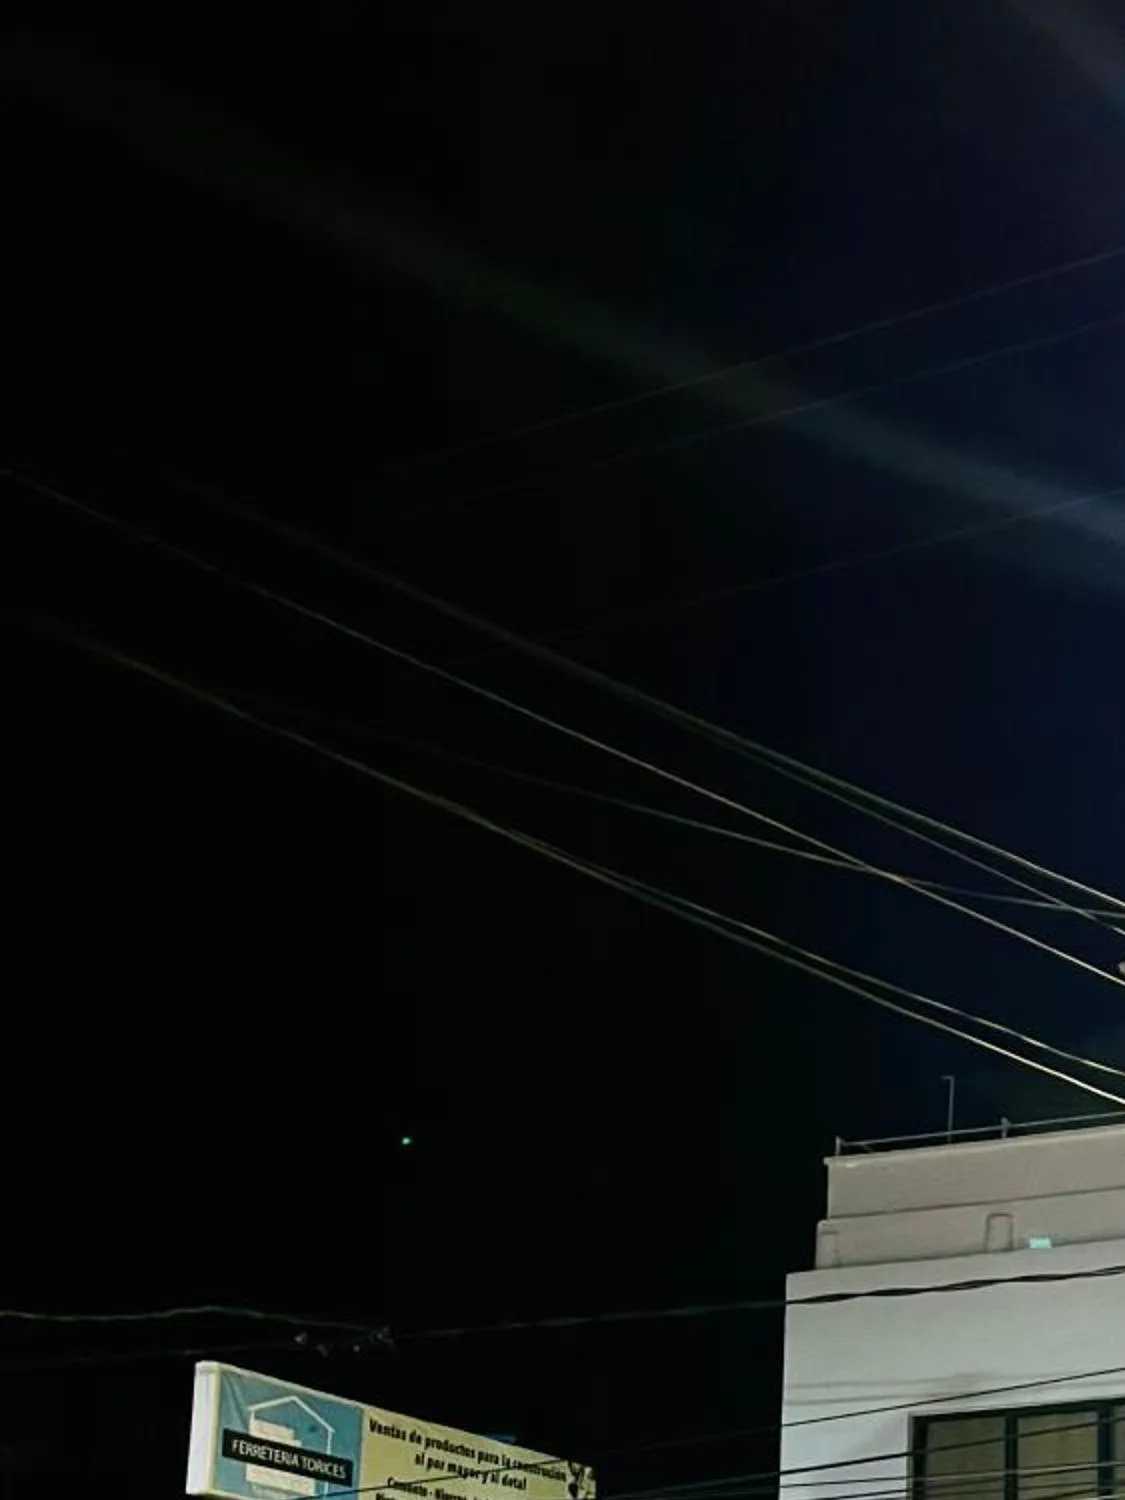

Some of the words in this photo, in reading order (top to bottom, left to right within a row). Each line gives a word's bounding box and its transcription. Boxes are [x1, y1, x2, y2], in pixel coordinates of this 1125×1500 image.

[368, 1417, 407, 1441] Ventas
[409, 1429, 422, 1445] de
[424, 1437, 475, 1460] productos
[477, 1450, 499, 1465] para
[426, 1456, 445, 1473] por
